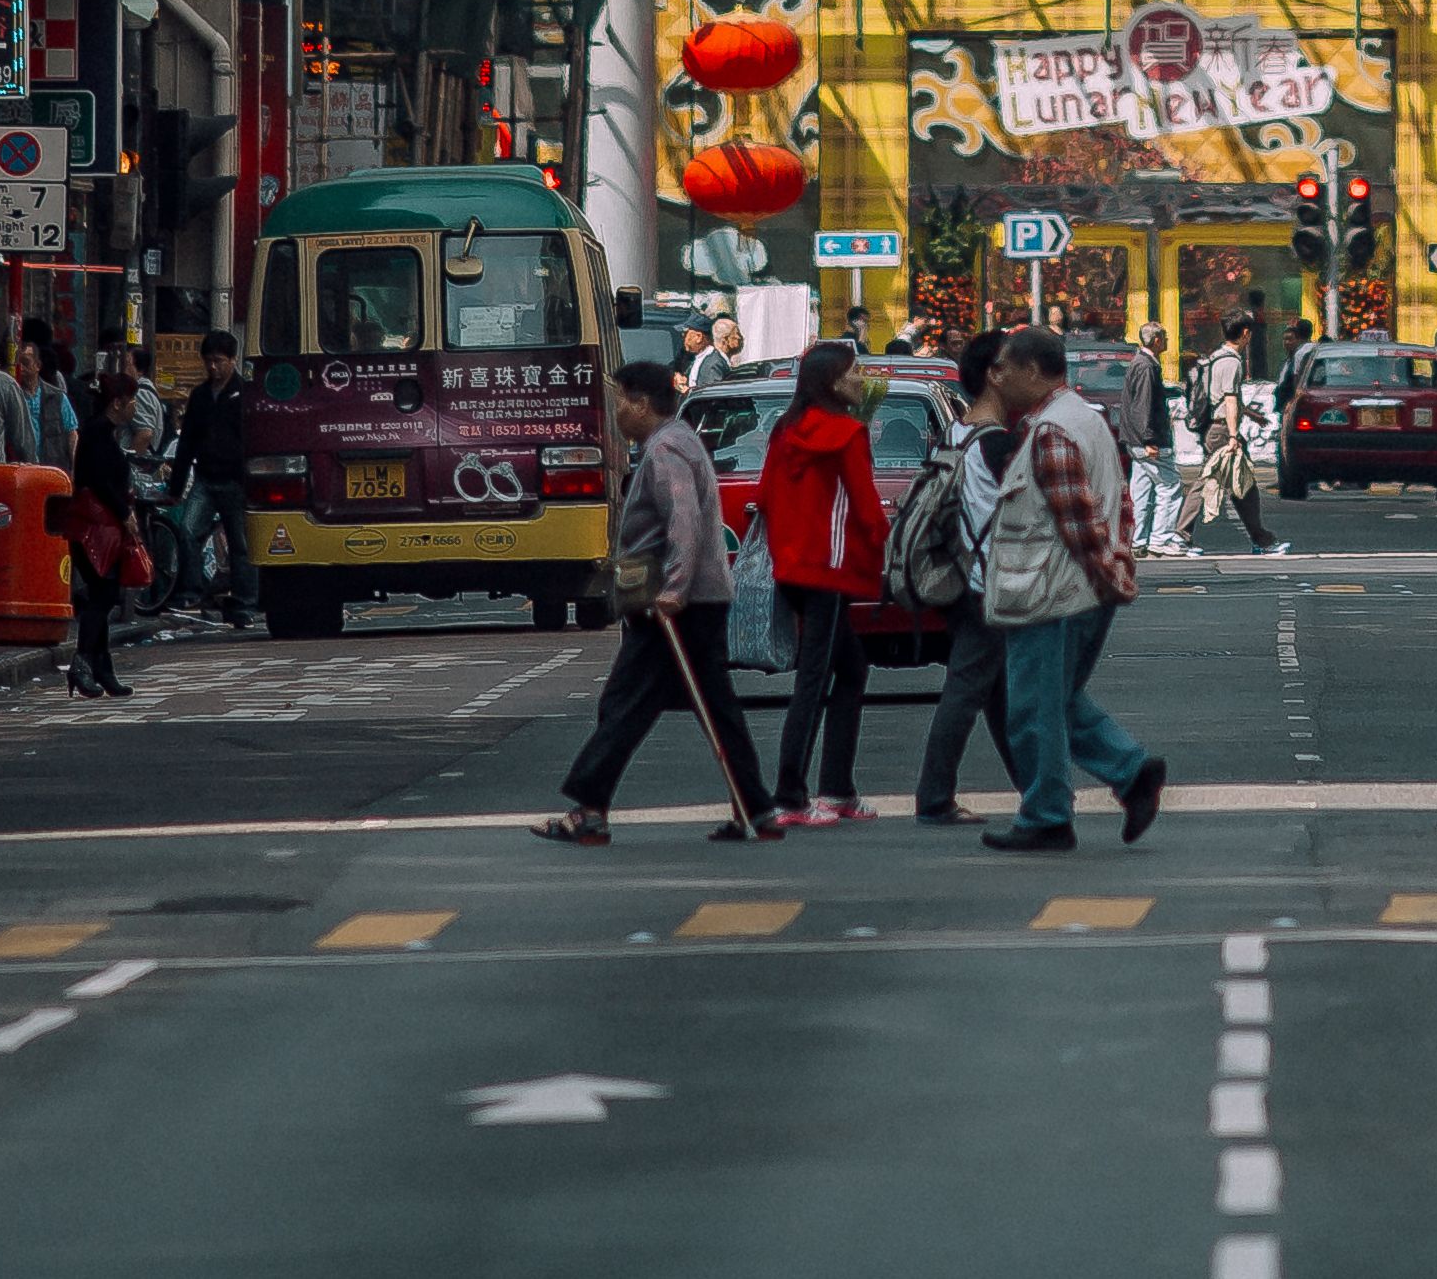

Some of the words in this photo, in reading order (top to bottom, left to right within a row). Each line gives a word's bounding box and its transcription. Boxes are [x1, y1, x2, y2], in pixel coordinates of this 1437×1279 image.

[1003, 42, 1123, 85] Happy
[1010, 86, 1131, 129] Lunar
[1219, 72, 1330, 120] Year
[29, 186, 48, 210] 7
[30, 223, 61, 247] 12
[1017, 221, 1038, 251] P
[363, 465, 388, 482] LM
[350, 481, 402, 498] 7056
